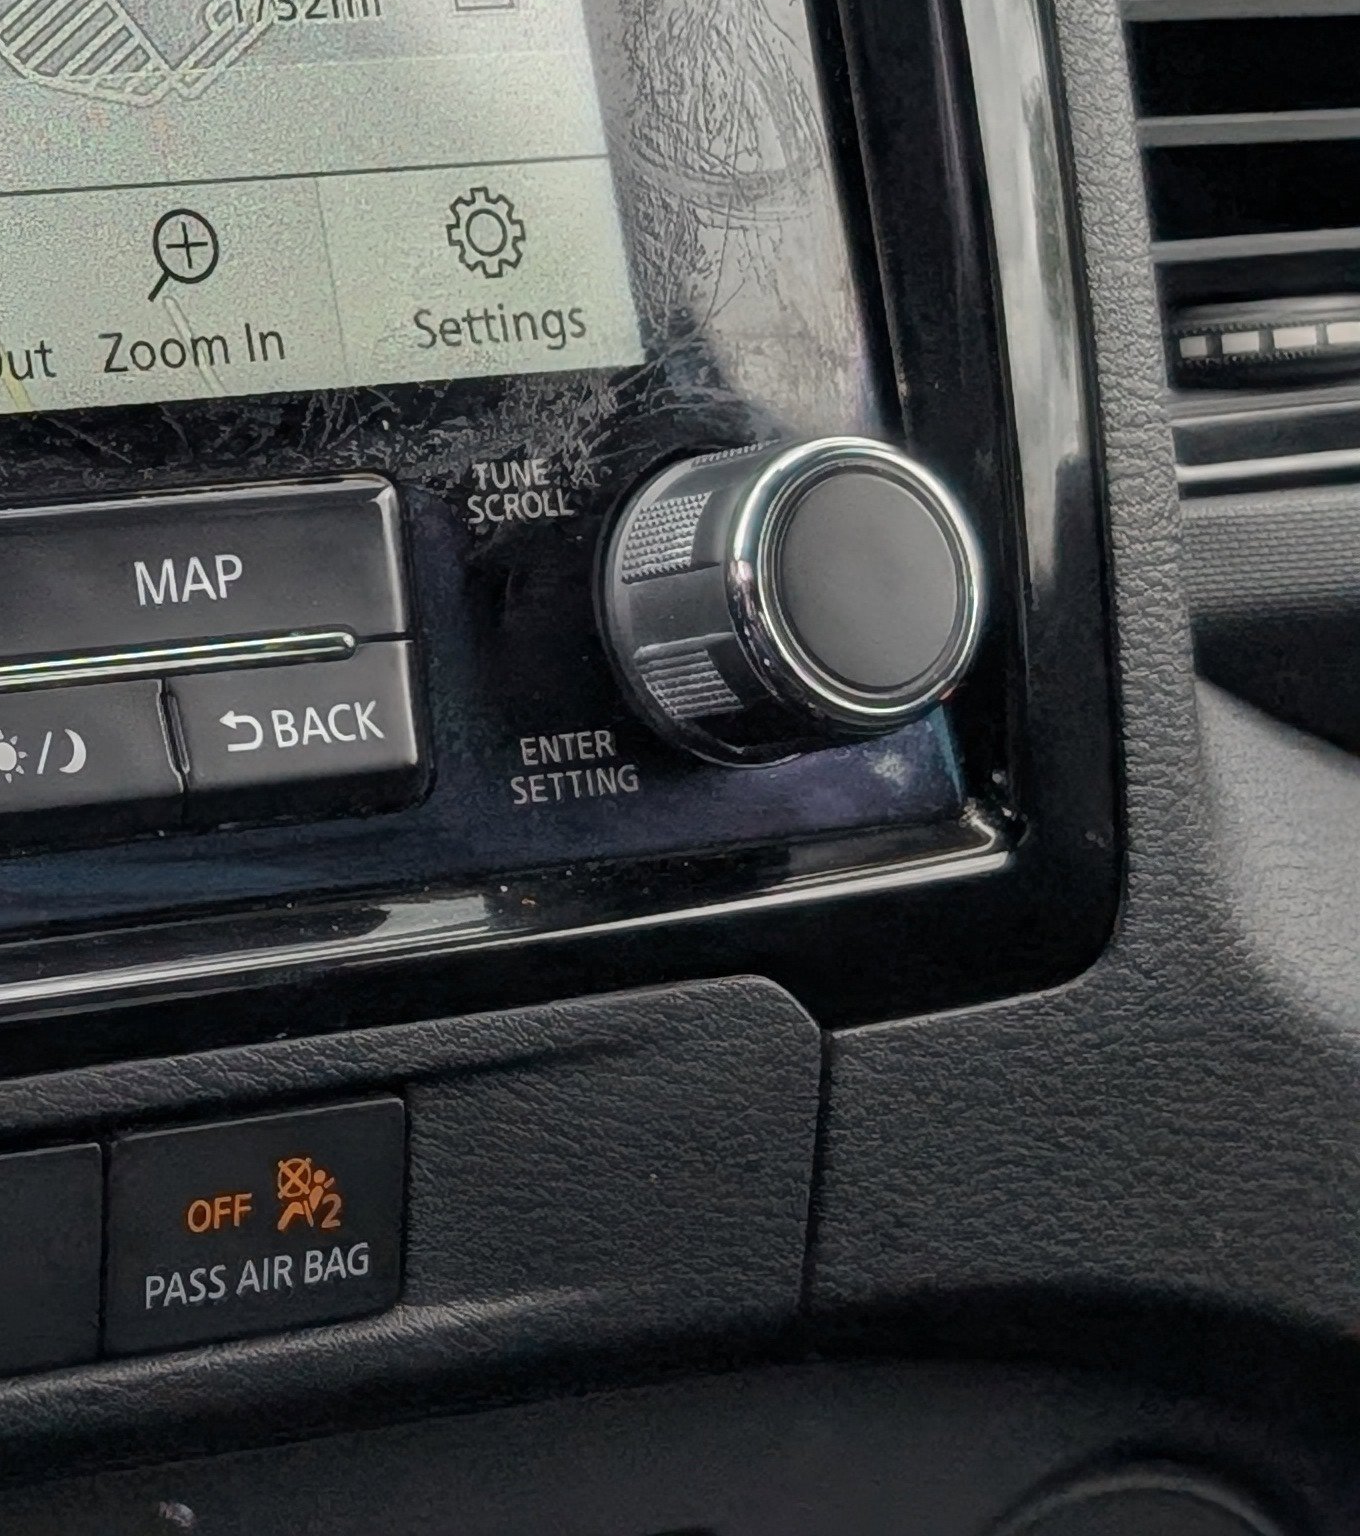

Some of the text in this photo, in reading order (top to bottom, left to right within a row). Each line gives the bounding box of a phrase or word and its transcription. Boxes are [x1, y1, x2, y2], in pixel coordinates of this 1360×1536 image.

[100, 324, 285, 374] Zoom In
[413, 305, 587, 350] Settings
[474, 461, 550, 492] TUNE
[467, 486, 575, 524] SCROLL
[134, 554, 244, 606] MAP
[273, 700, 385, 749] BACK
[521, 730, 616, 768] ENTER
[511, 765, 641, 806] SETTING
[187, 1192, 253, 1233] OFF
[145, 1242, 369, 1310] PASS AIR BAG
